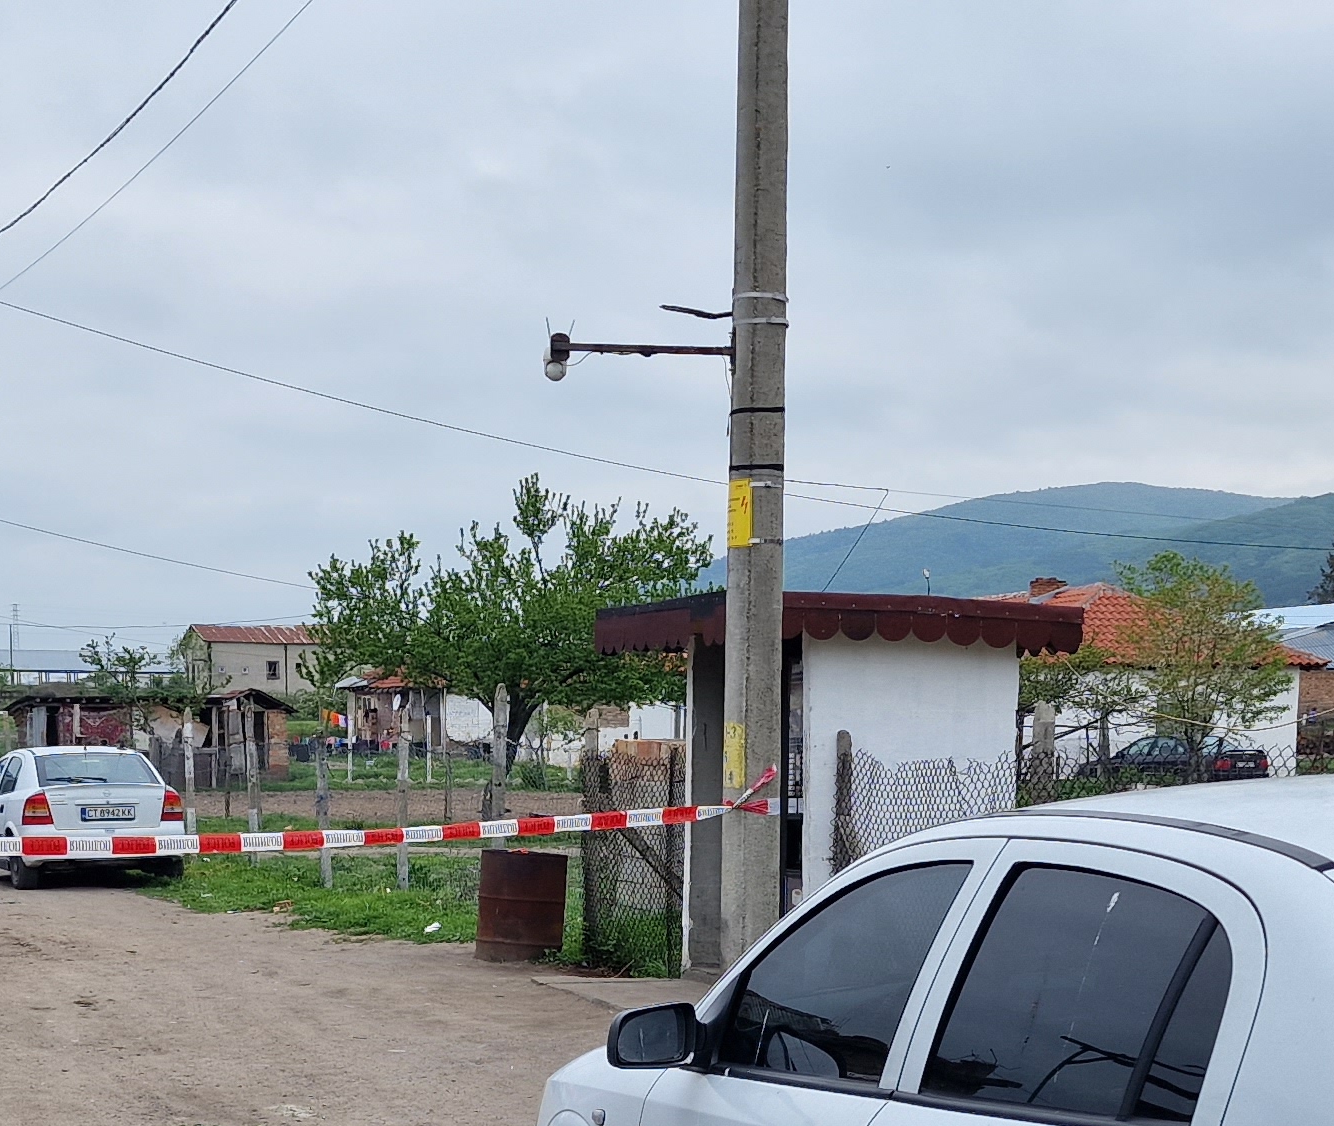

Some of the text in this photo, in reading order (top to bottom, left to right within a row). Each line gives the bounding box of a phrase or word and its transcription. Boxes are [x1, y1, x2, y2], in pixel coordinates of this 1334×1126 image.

[87, 808, 133, 818] CT 8942 KK
[406, 829, 442, 840] ПОЛИЦИЯ
[482, 823, 517, 835] ПОЛИЦИЯ
[244, 836, 282, 847] ПОЛИЦИЯ
[325, 832, 364, 844] ПОЛИЦИЯ
[70, 840, 111, 851] ПОЛИЦИЯ
[158, 839, 198, 850] ПОЛИЦИЯ
